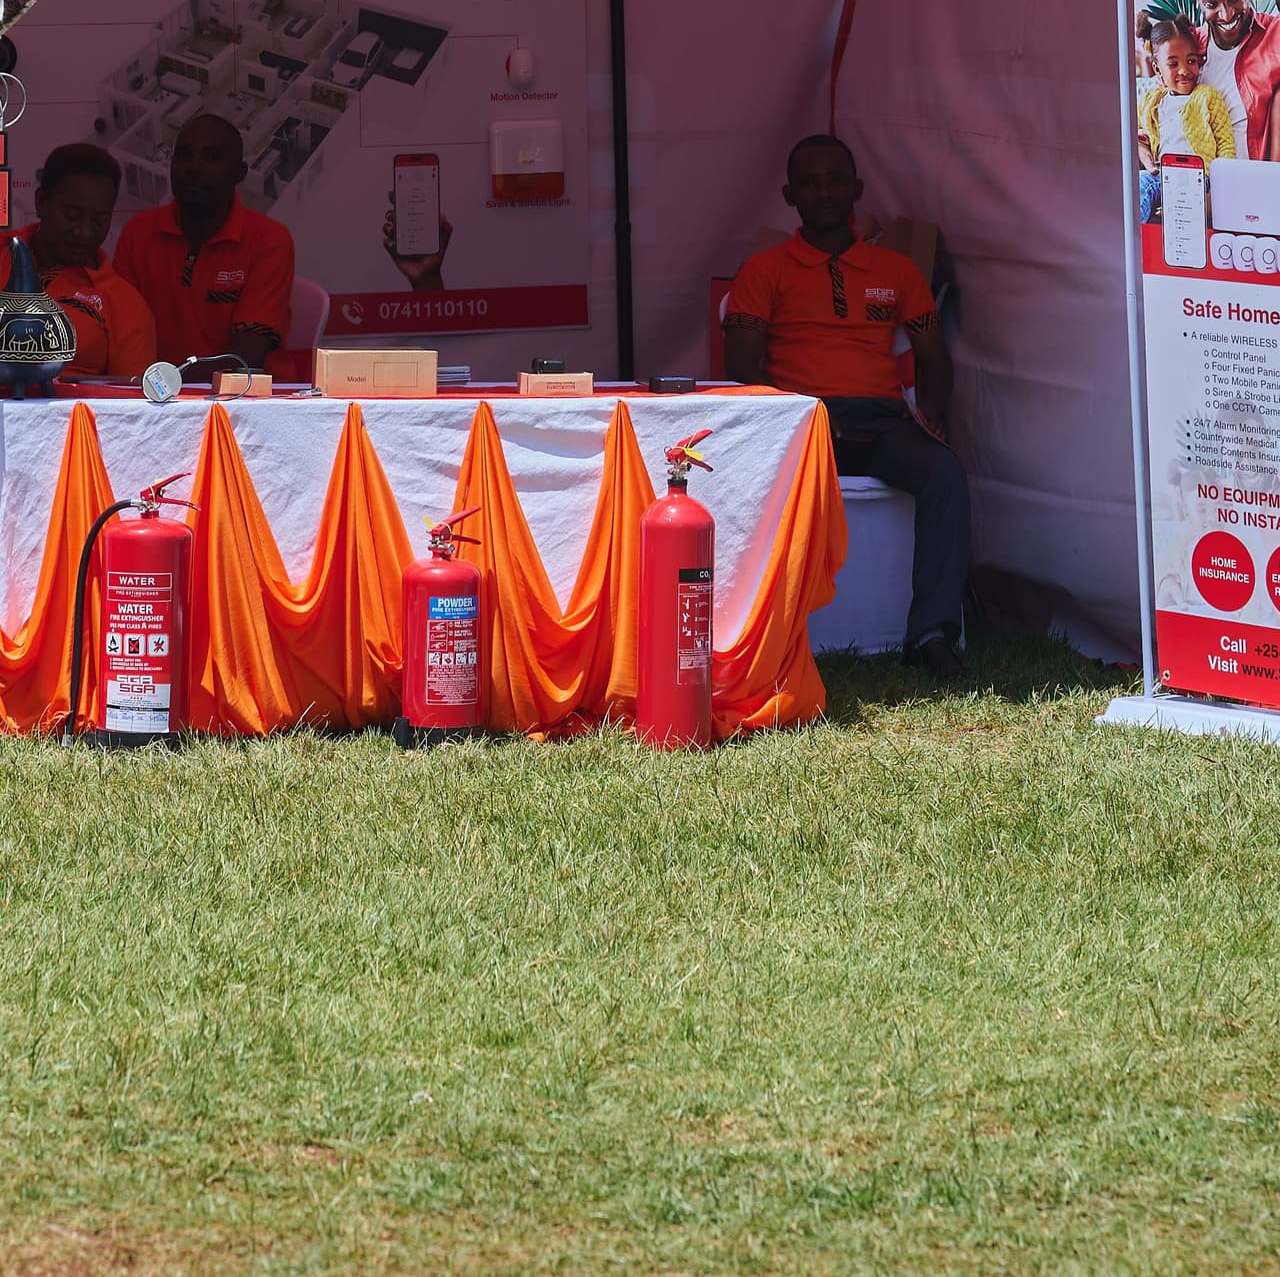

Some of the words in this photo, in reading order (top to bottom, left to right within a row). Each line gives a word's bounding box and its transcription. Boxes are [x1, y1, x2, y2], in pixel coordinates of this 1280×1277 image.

[490, 92, 520, 102] Motion
[522, 91, 559, 101] Detector
[379, 298, 488, 320] 0741110110
[1182, 297, 1222, 320] Safe
[1228, 302, 1280, 325] Home
[1191, 331, 1198, 340] A
[1200, 332, 1229, 344] reliable
[1231, 335, 1278, 349] WIRELESS
[1211, 349, 1241, 361] Control
[1243, 352, 1266, 363] Panel
[1212, 362, 1230, 372] Four
[1232, 364, 1255, 375] Fixed
[1258, 366, 1280, 378] Panic
[347, 375, 367, 383] Model
[1212, 374, 1230, 385] Two
[1232, 376, 1258, 388] Mobile
[1212, 388, 1234, 398] Siren
[1244, 391, 1271, 403] Strobe
[1213, 400, 1230, 411] One
[1232, 402, 1256, 414] CCTV
[1194, 418, 1212, 428] 24/7
[1214, 420, 1237, 431] Alarm
[1194, 430, 1244, 446] Countrywide
[1246, 437, 1277, 450] Medical
[1194, 444, 1218, 455] Home
[1220, 447, 1256, 461] Contents
[1195, 456, 1232, 470] Roadside
[1234, 461, 1278, 476] Assistance
[1197, 483, 1219, 500] NO
[1217, 508, 1239, 525] NO
[1211, 556, 1237, 569] HOME
[119, 576, 156, 586] WATER
[1199, 567, 1250, 584] INSURANCE
[118, 604, 153, 614] WATER
[438, 598, 472, 608] POWDER
[1220, 635, 1247, 654] Call
[1208, 654, 1239, 674] Visit
[116, 674, 153, 683] SGA
[120, 684, 156, 694] SGA
